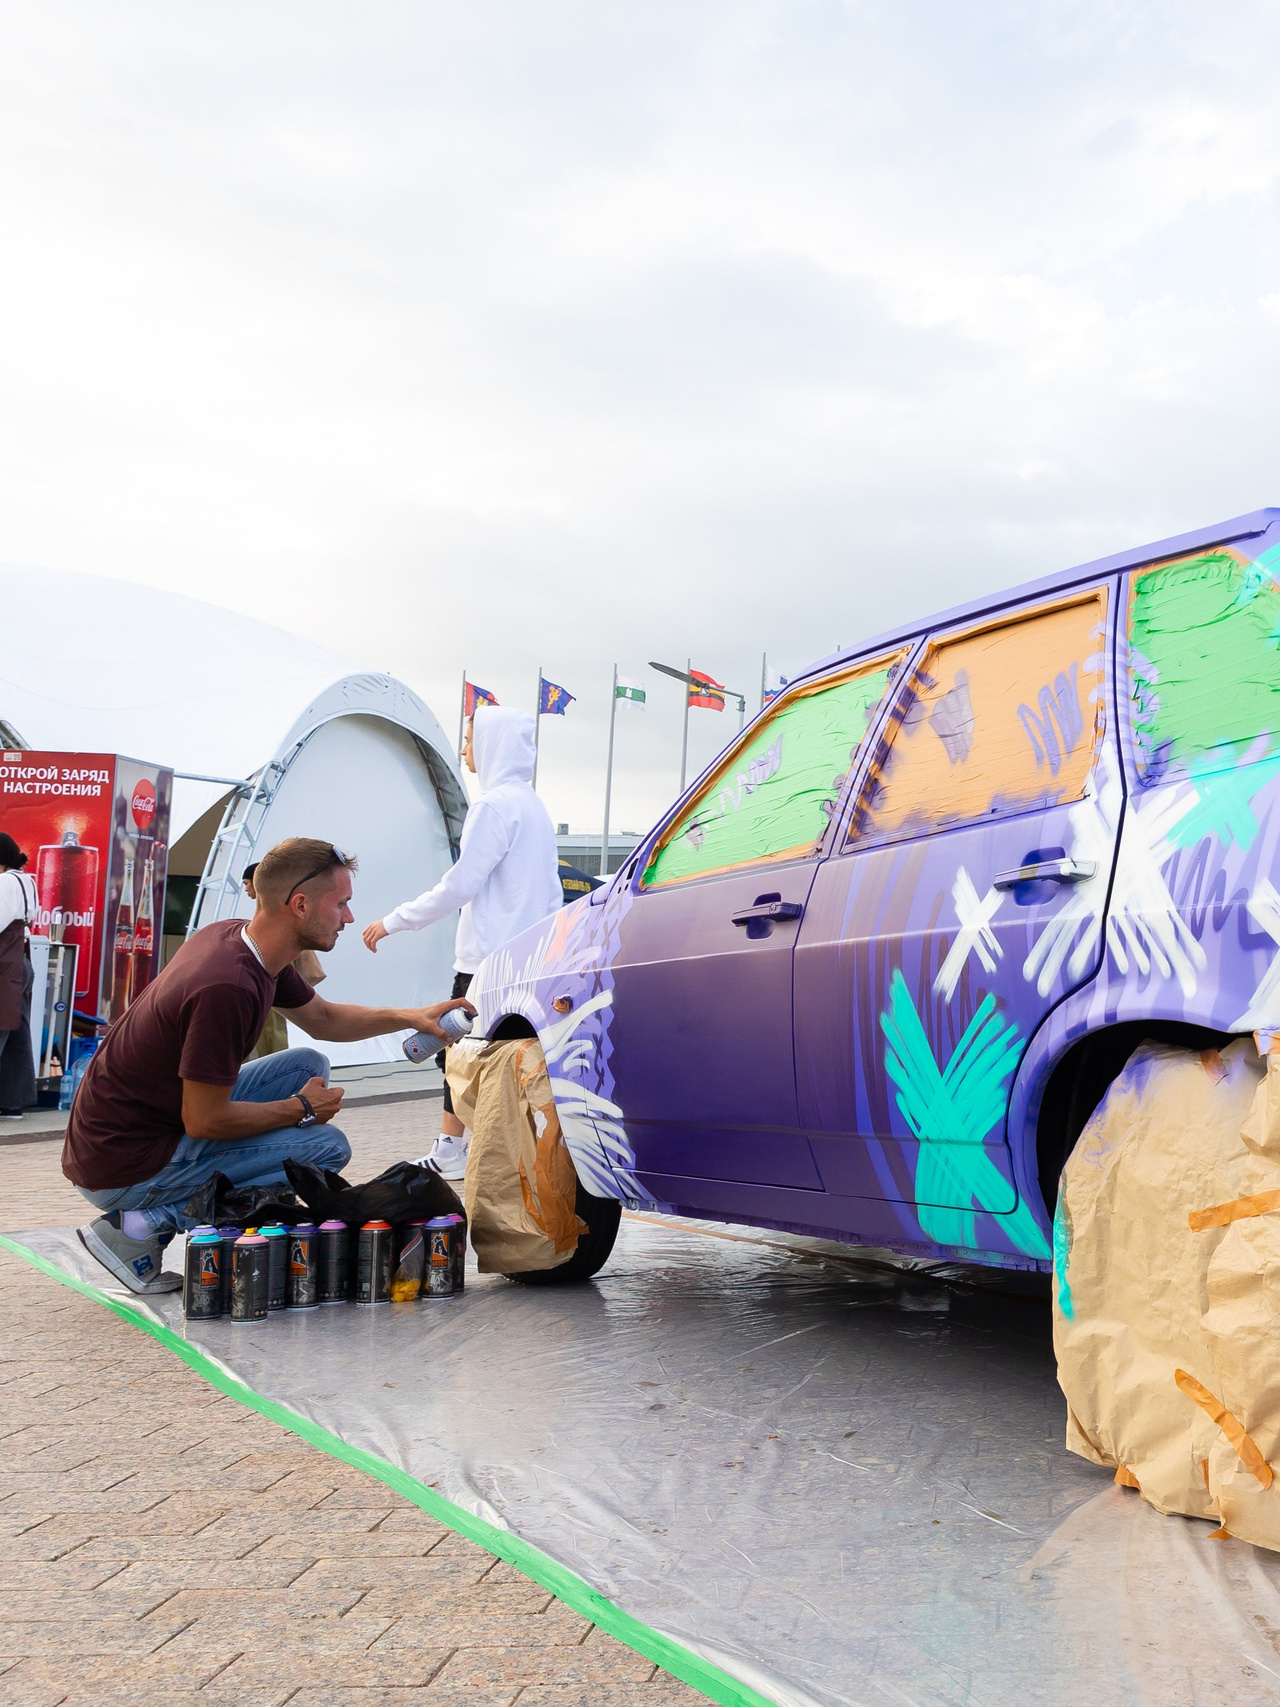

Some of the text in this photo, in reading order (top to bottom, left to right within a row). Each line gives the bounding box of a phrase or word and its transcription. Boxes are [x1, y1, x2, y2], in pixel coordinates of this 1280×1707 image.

[0, 766, 109, 784] ОТКРОЙ ЗАРЯД
[3, 781, 101, 796] НАСТРОЕНИЯ
